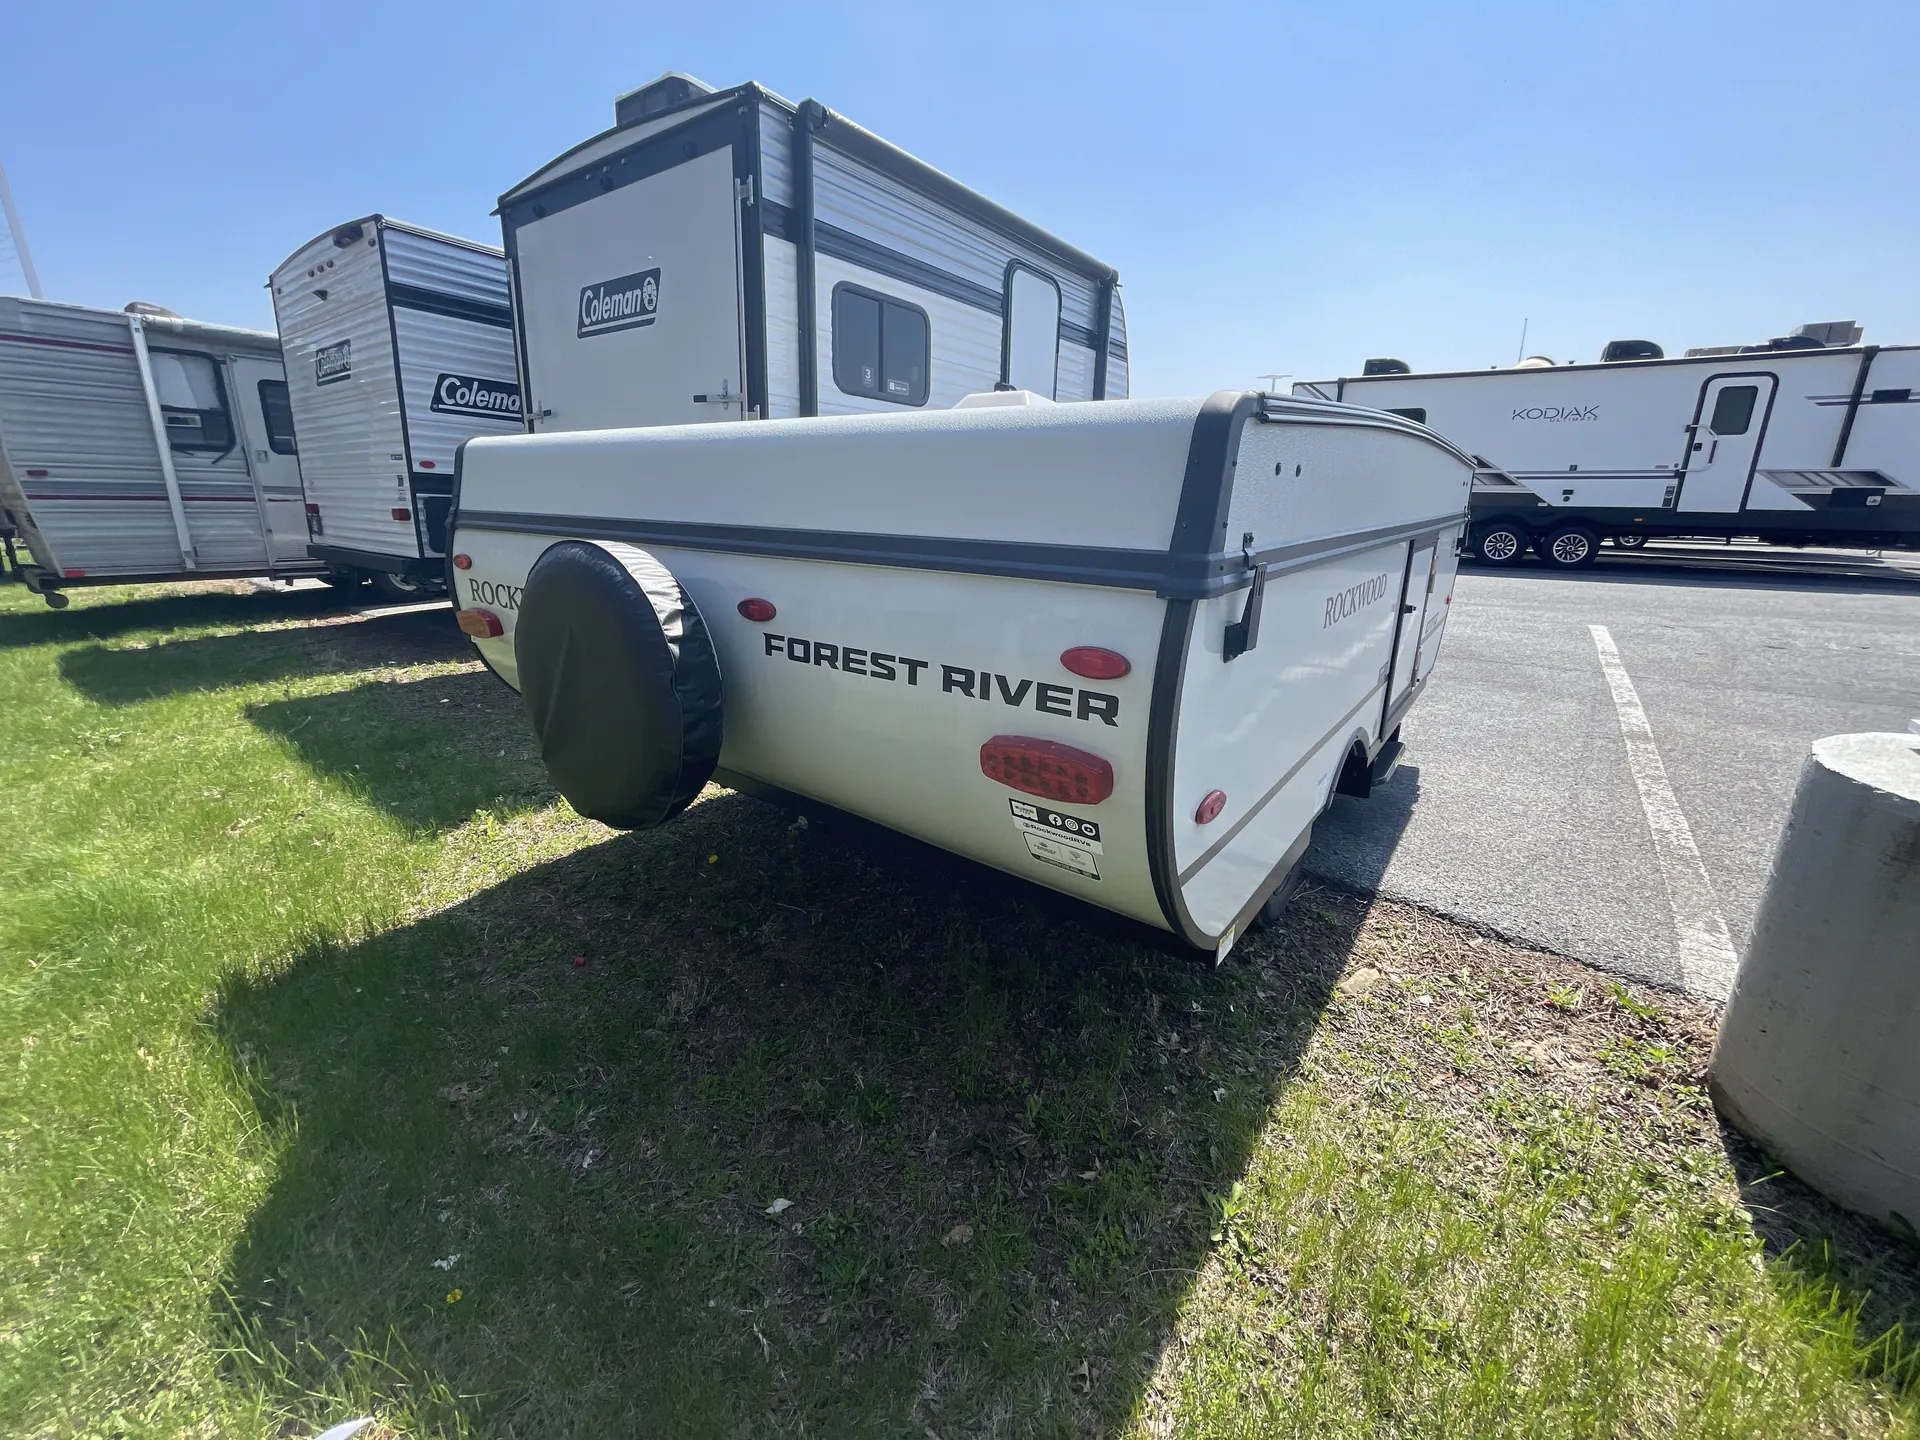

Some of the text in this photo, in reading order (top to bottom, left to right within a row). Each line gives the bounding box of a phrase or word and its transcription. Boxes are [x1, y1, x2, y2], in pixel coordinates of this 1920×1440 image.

[582, 287, 641, 325] Coleman
[865, 368, 873, 379] 3
[440, 377, 521, 411] Colema
[1512, 405, 1600, 420] KODIAK
[469, 578, 524, 610] ROCK
[1323, 573, 1387, 629] ROCKWOOD
[763, 632, 1119, 727] FOREST RIVER
[1022, 822, 1092, 847] @RockwoodRVs
